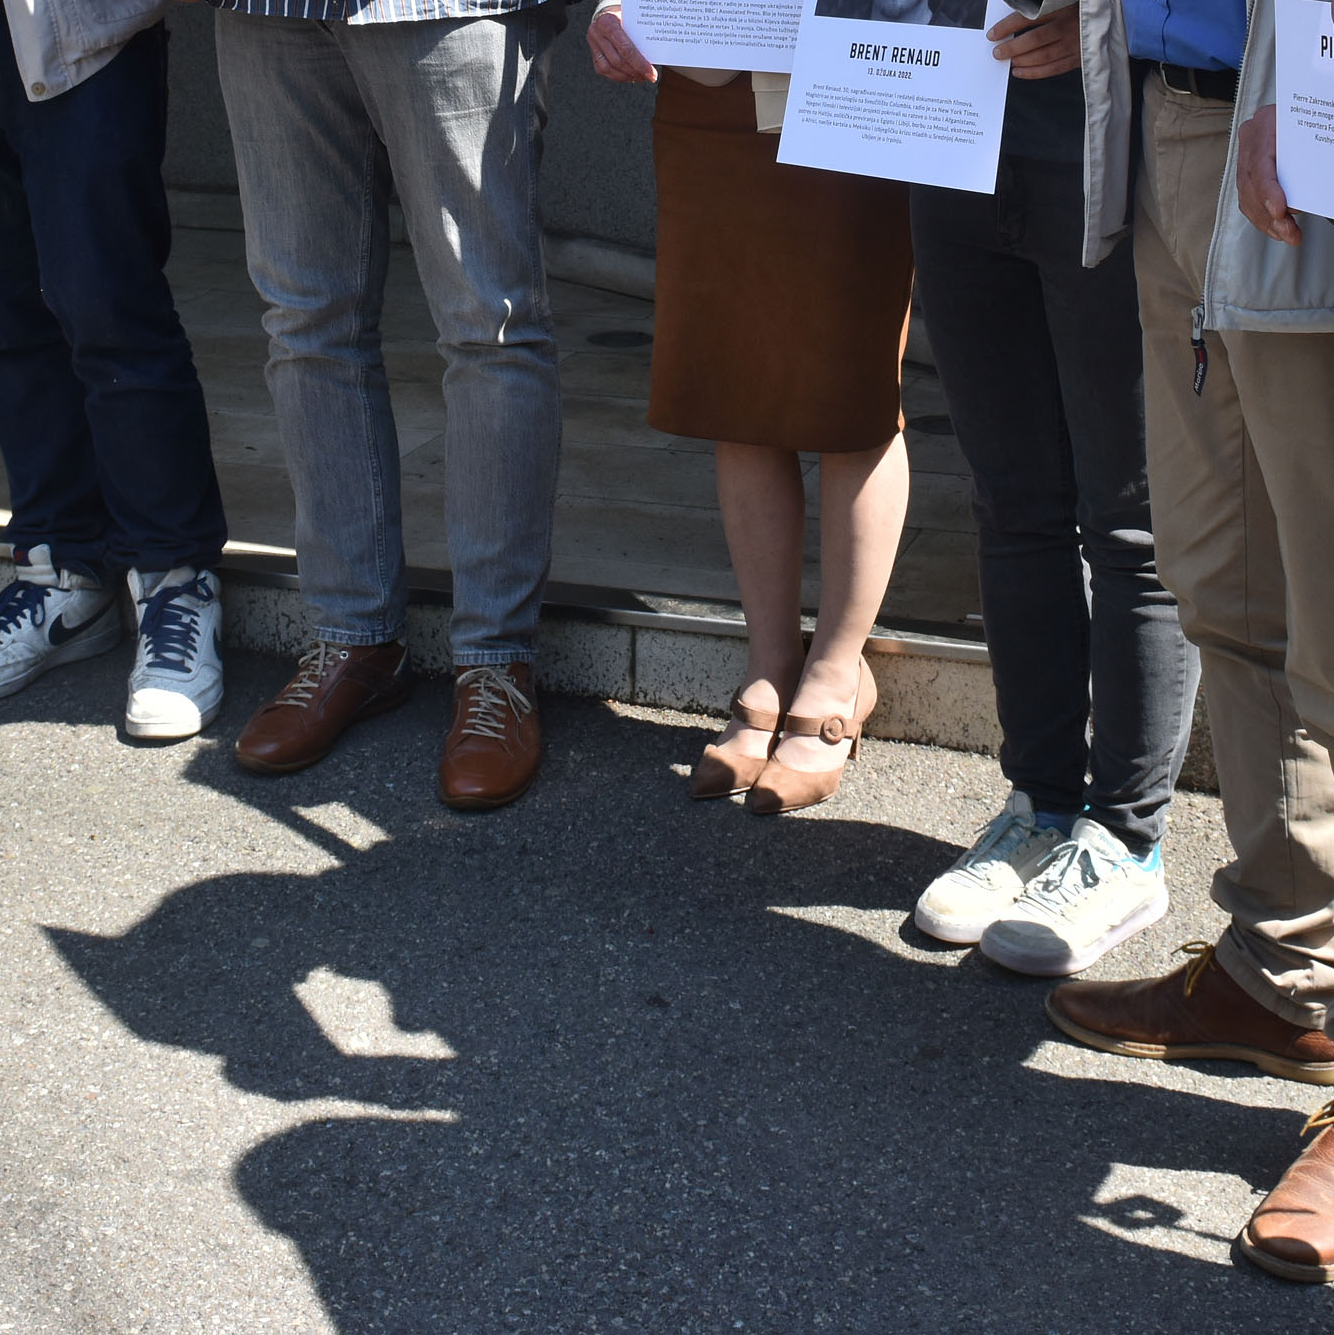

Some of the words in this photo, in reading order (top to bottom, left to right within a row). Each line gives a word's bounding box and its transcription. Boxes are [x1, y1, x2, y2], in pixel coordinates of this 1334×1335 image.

[849, 43, 888, 62] BRENT
[891, 46, 940, 67] RENAUD
[876, 68, 896, 77] OŽUJKA
[897, 71, 912, 79] 2022.
